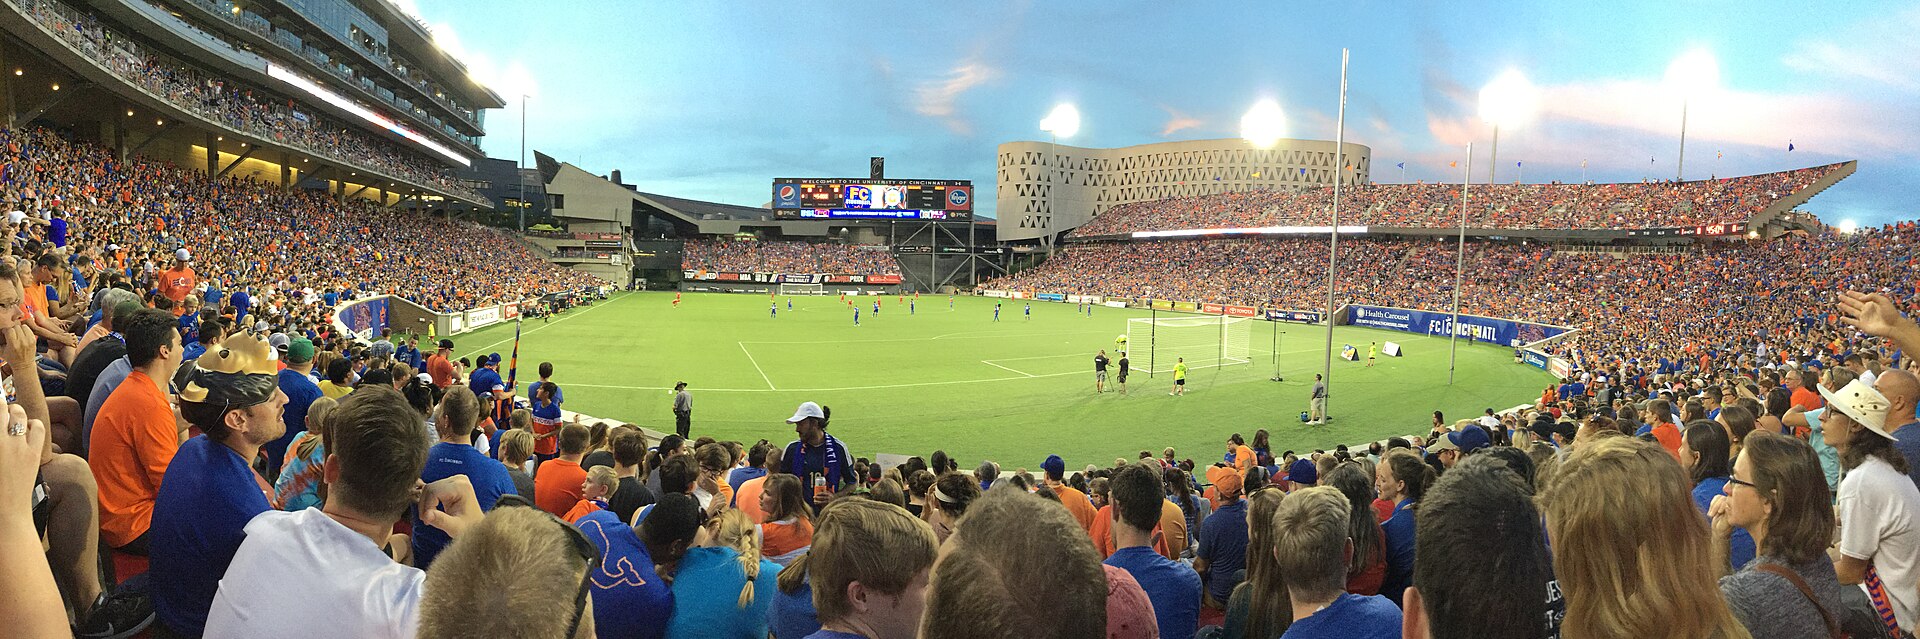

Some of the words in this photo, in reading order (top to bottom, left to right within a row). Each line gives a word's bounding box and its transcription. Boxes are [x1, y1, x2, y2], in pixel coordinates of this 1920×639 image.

[850, 187, 869, 201] FC
[1365, 309, 1384, 318] Health
[1384, 311, 1410, 321] Carousel
